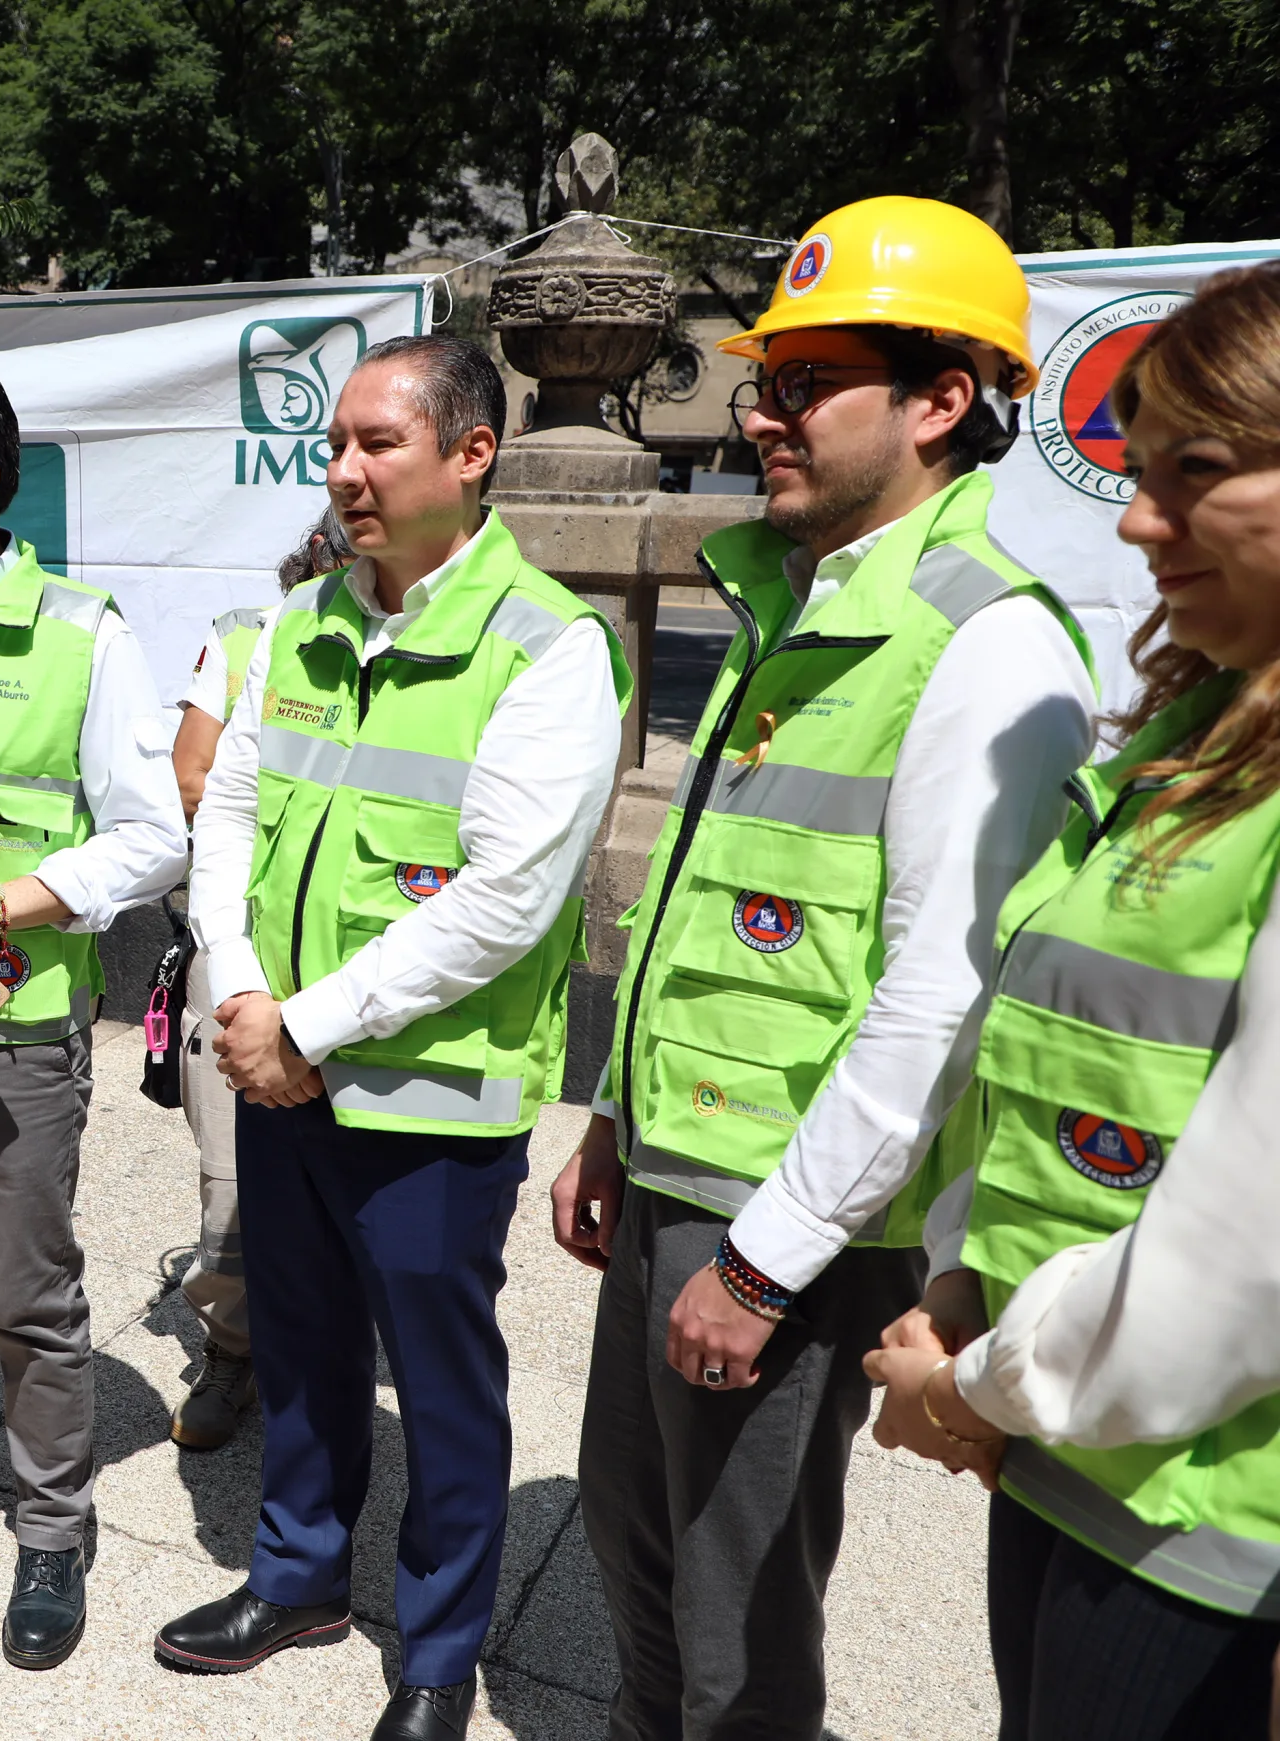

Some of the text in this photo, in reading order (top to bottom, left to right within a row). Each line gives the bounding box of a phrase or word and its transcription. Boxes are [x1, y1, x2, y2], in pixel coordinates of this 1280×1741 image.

[1041, 337, 1082, 401] INSTITUTO
[1082, 302, 1161, 339] MEXICANO
[235, 438, 328, 486] IMS
[1036, 417, 1138, 499] PROTECC
[13, 680, 24, 689] A.
[275, 706, 320, 725] MÉXICO
[279, 697, 314, 711] GOBIERNO
[728, 1098, 798, 1124] SINAPROC
